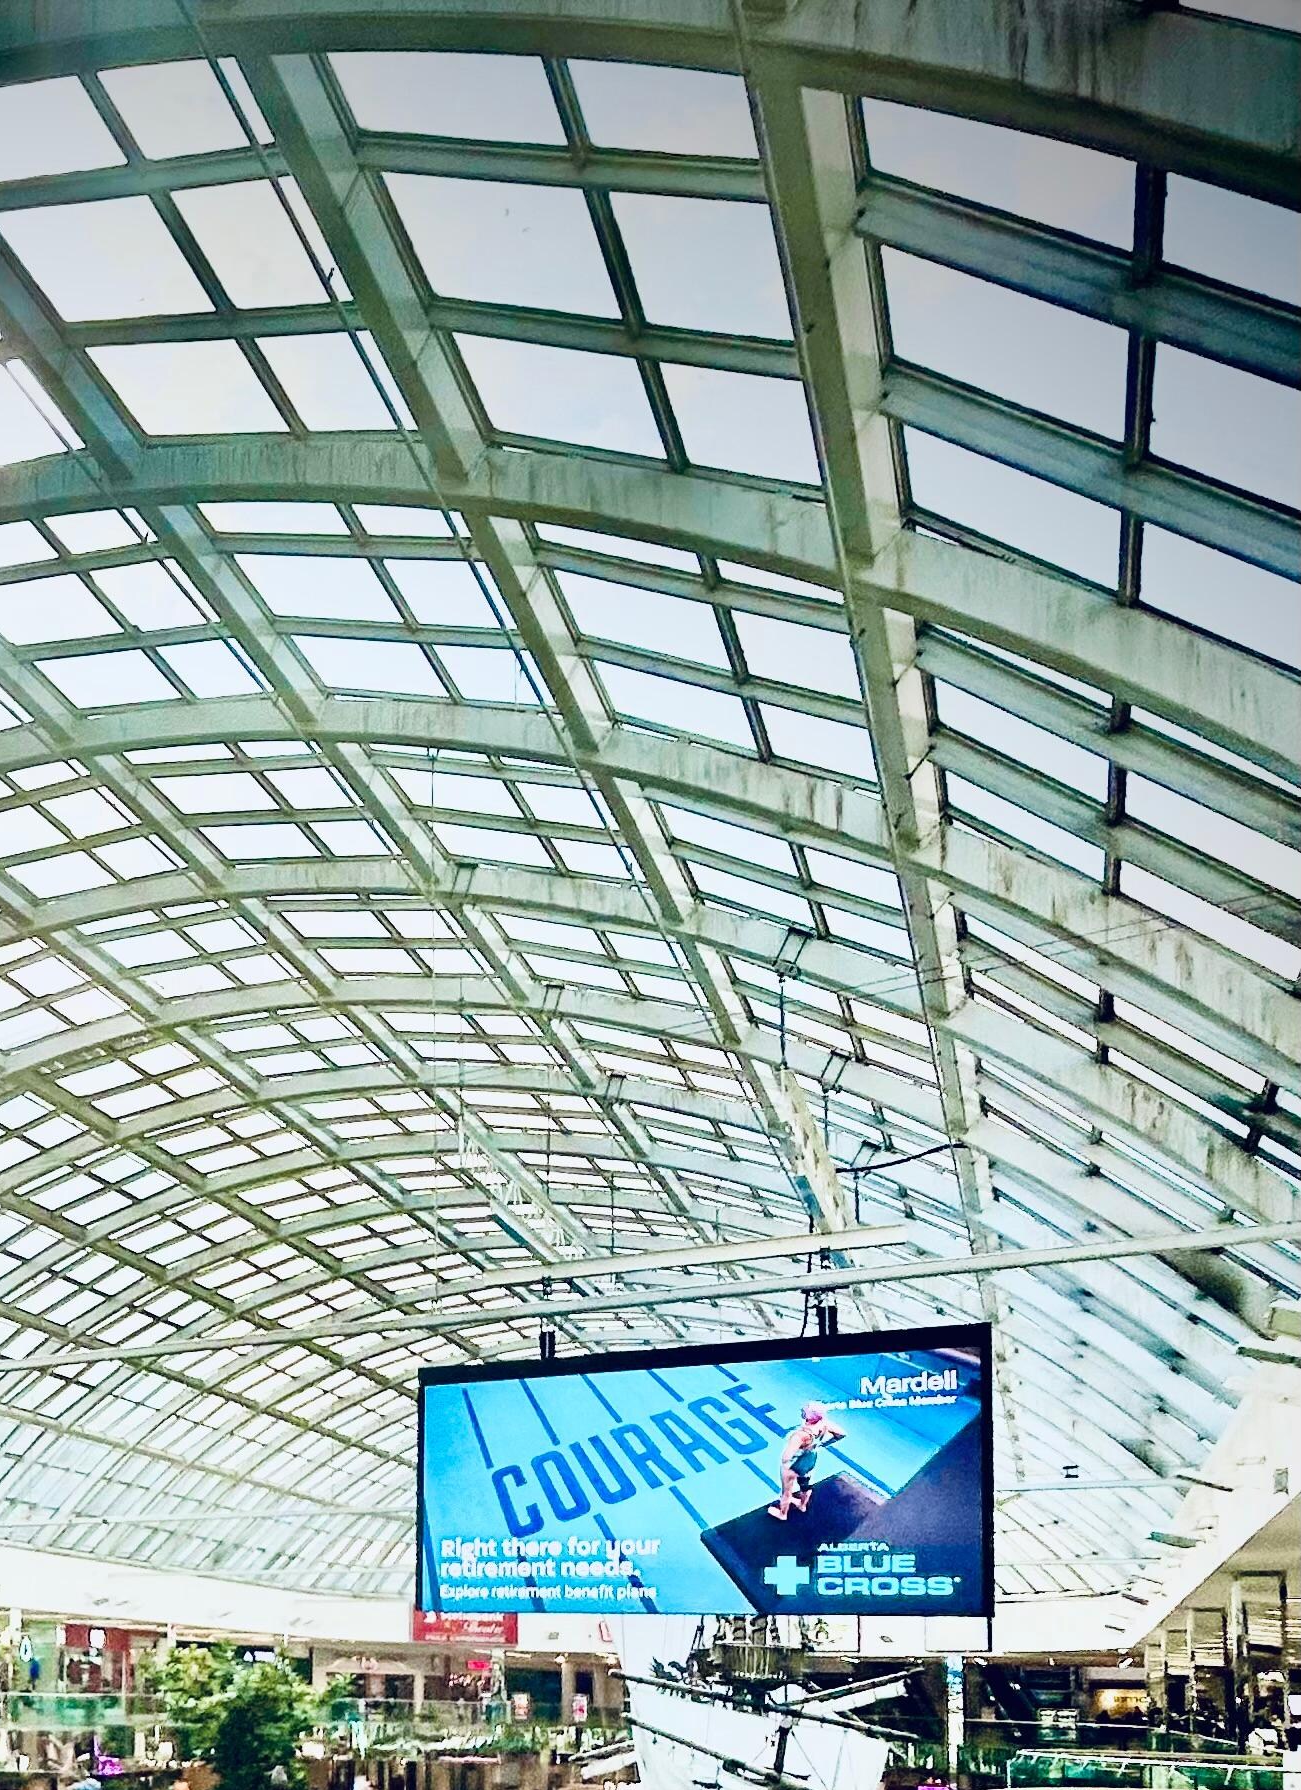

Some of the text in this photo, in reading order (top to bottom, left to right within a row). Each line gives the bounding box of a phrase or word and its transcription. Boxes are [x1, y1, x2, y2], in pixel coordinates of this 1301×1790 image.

[860, 1369, 958, 1396] Mardell
[491, 1383, 790, 1538] COURAGE
[440, 1536, 660, 1561] Right there for your
[817, 1541, 890, 1552] ALBERTA
[441, 1557, 642, 1577] retirement needs.
[816, 1554, 916, 1574] BLUE
[440, 1583, 658, 1601] Explore retirement benefit plans
[817, 1576, 955, 1597] CROSS
